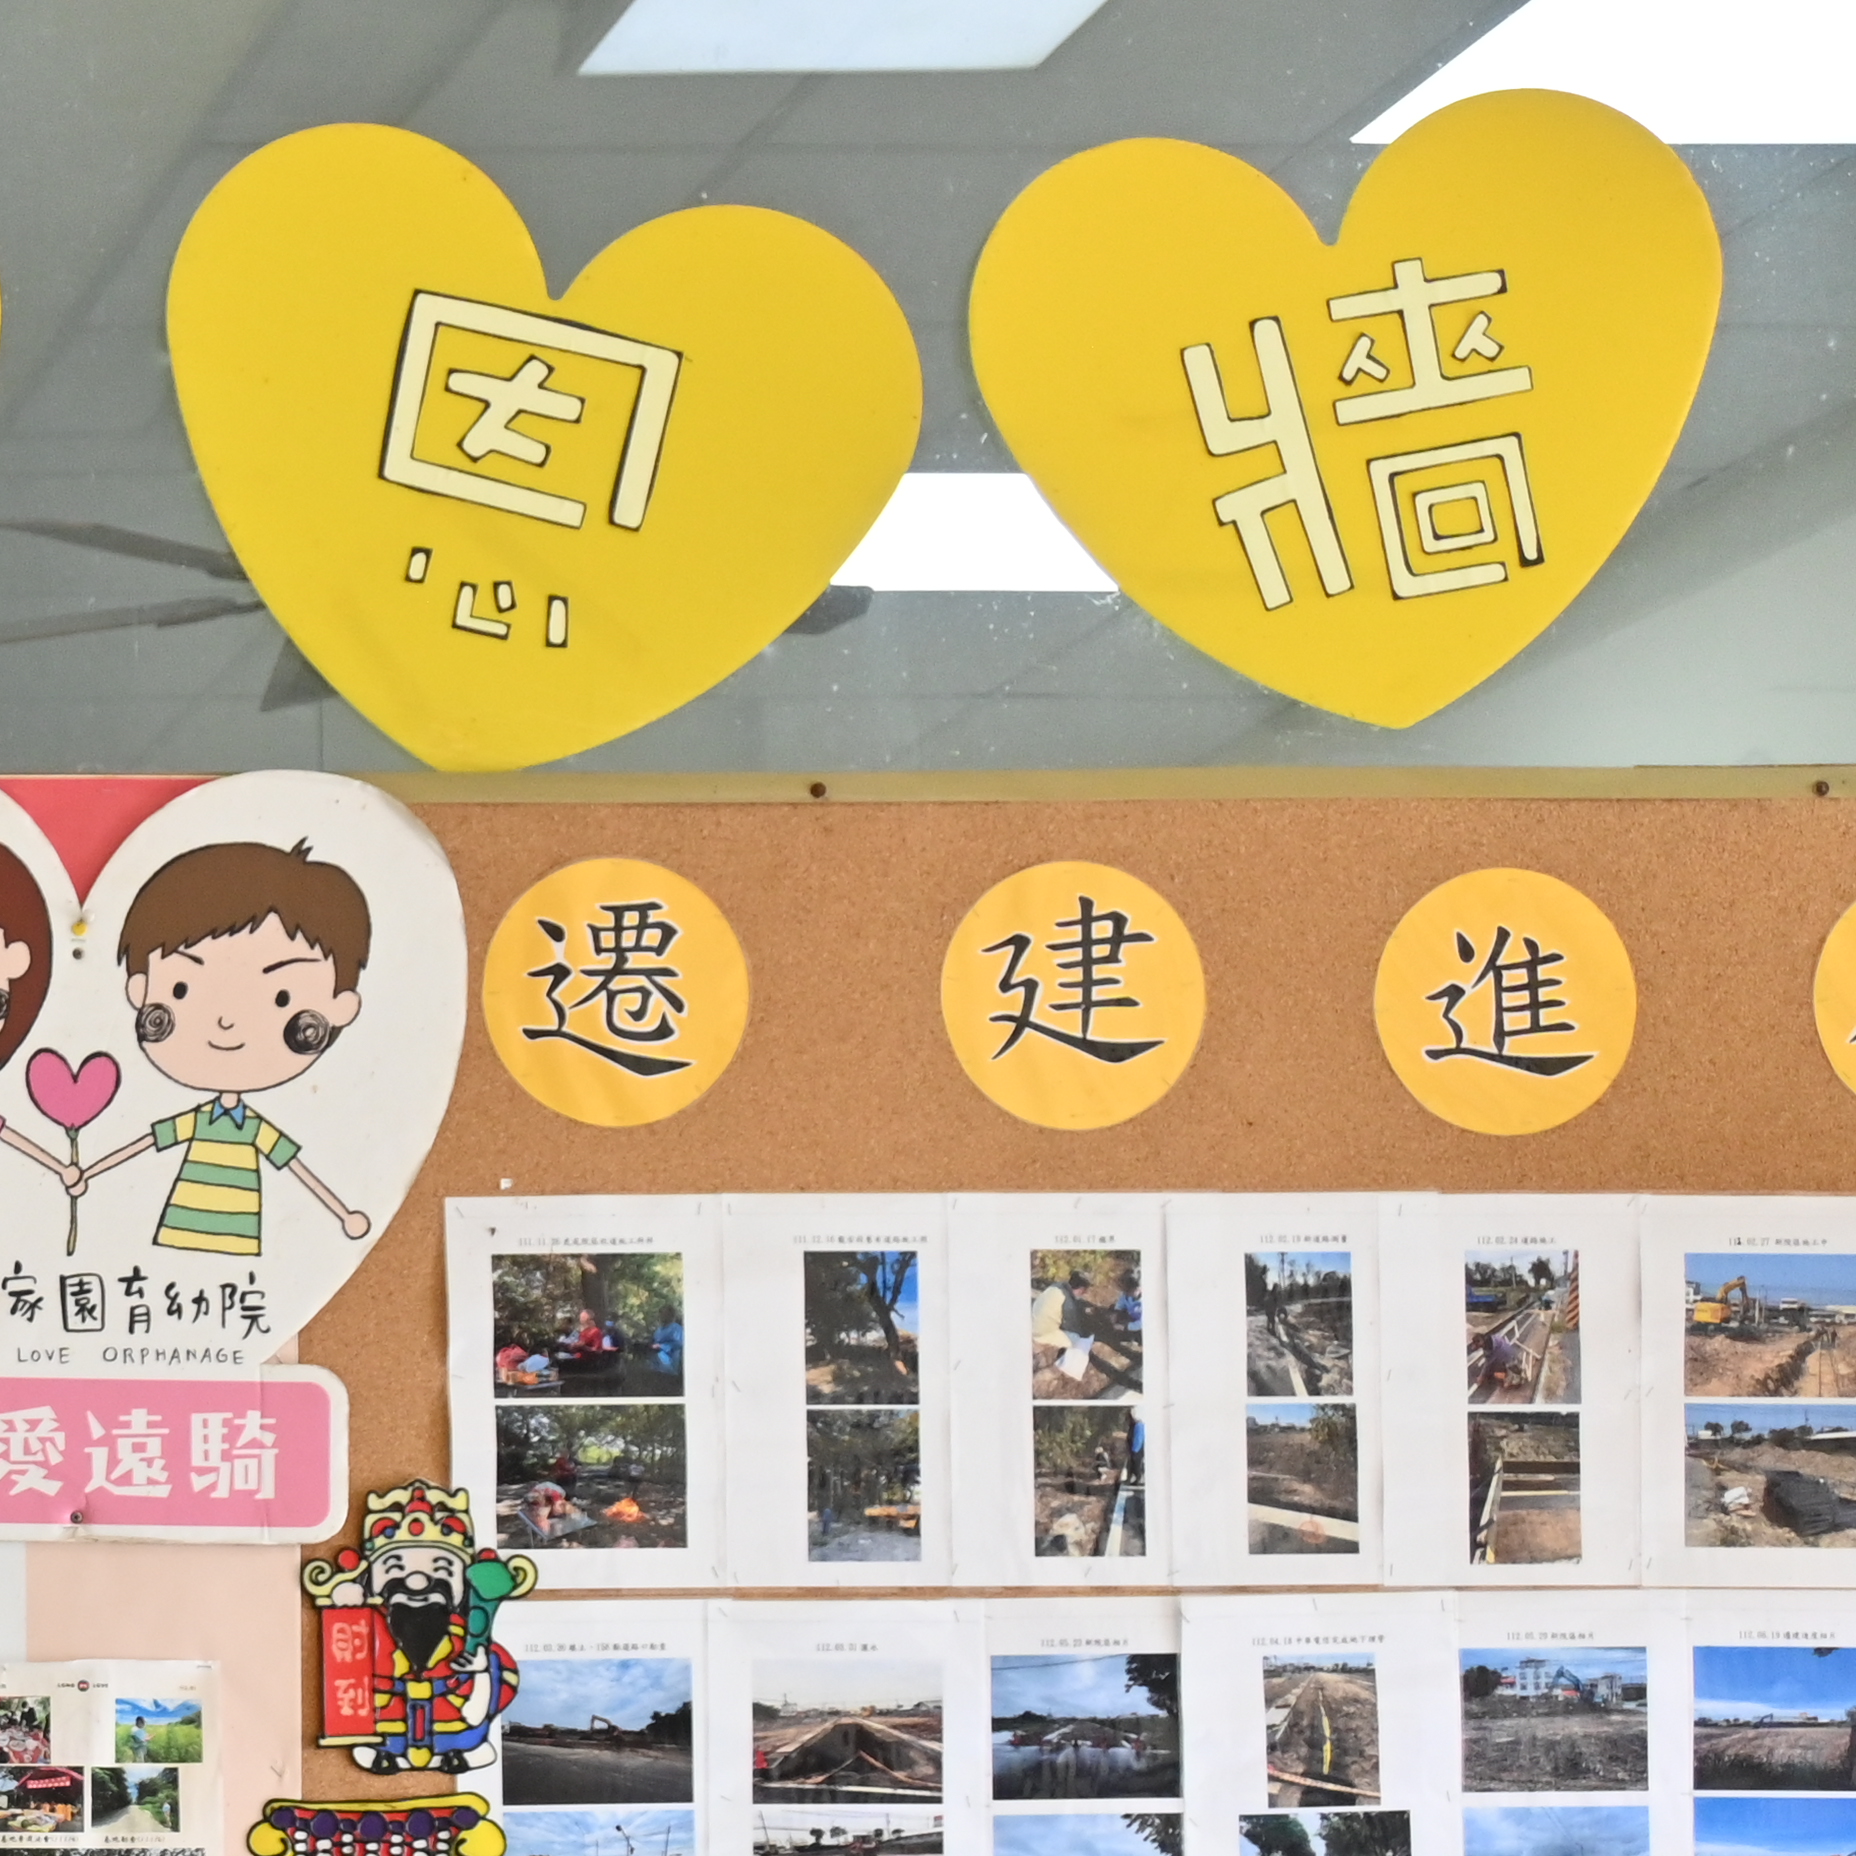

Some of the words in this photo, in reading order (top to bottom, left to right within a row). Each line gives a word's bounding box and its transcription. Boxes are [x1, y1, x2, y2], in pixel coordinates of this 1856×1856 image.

[378, 289, 683, 648] 恩
[1181, 257, 1545, 613] 牆
[522, 900, 696, 1079] 遷
[978, 894, 1166, 1065] 建
[1423, 925, 1598, 1077] 進
[17, 1346, 71, 1366] LOVE
[102, 1346, 245, 1367] ORPHANAGE
[330, 1620, 371, 1717] 財到
